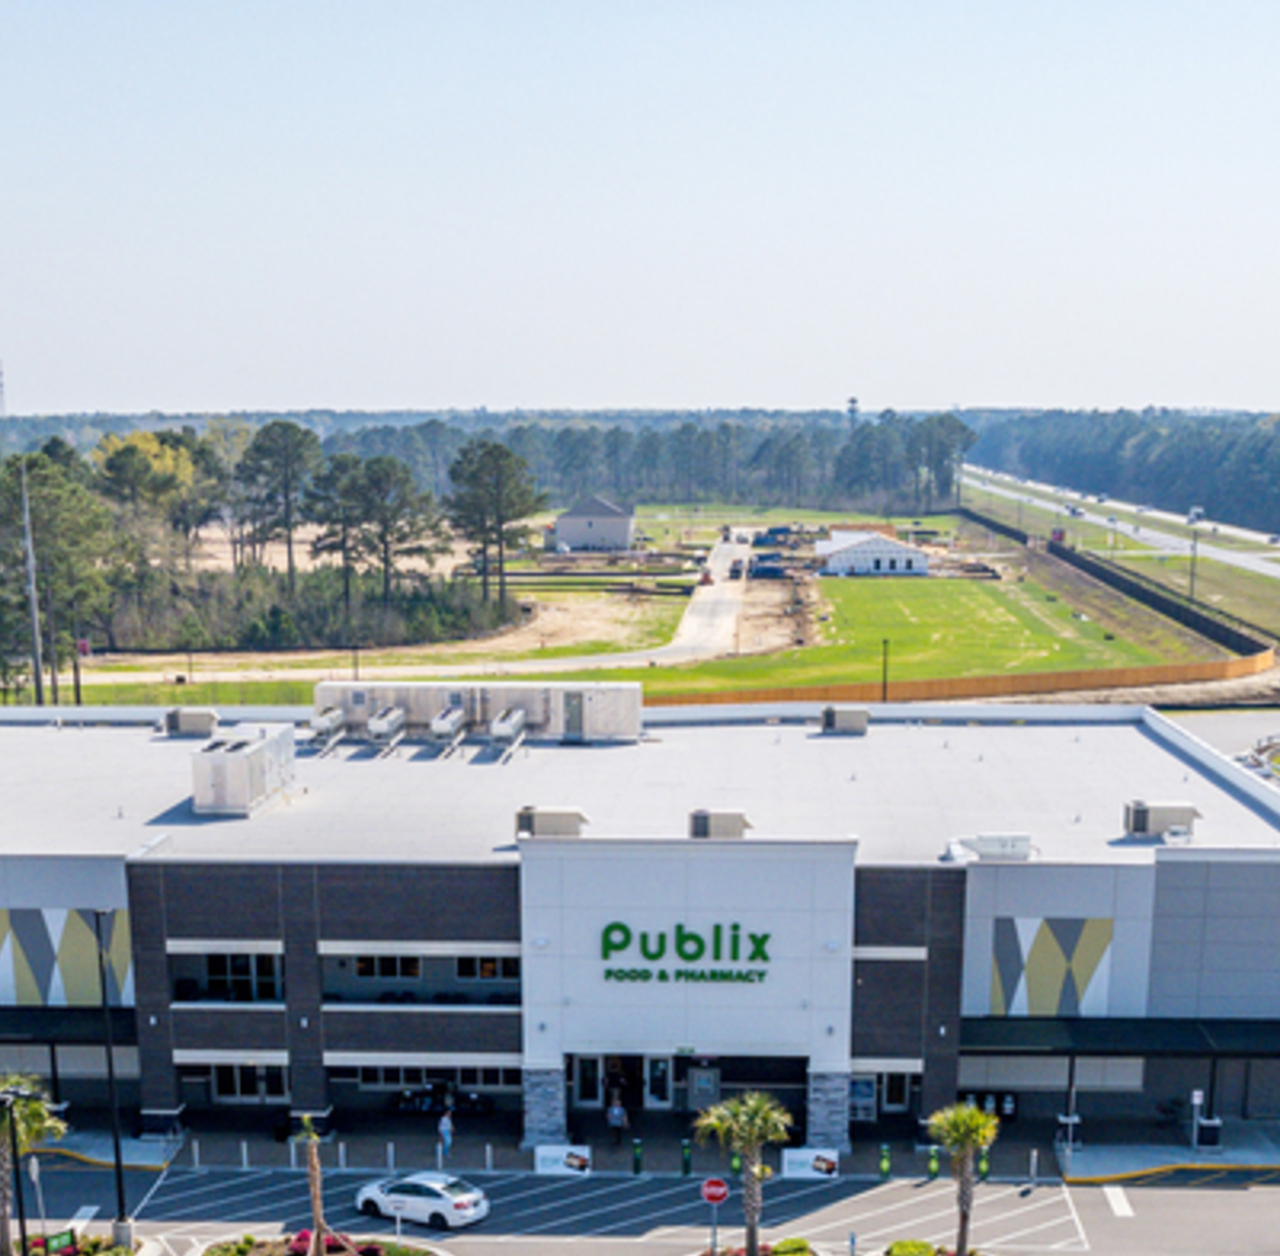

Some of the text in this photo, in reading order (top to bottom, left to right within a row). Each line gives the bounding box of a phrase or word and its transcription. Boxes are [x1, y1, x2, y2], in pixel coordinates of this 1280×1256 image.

[601, 921, 771, 962] Publix
[604, 969, 767, 983] FOOD & PHARMACY
